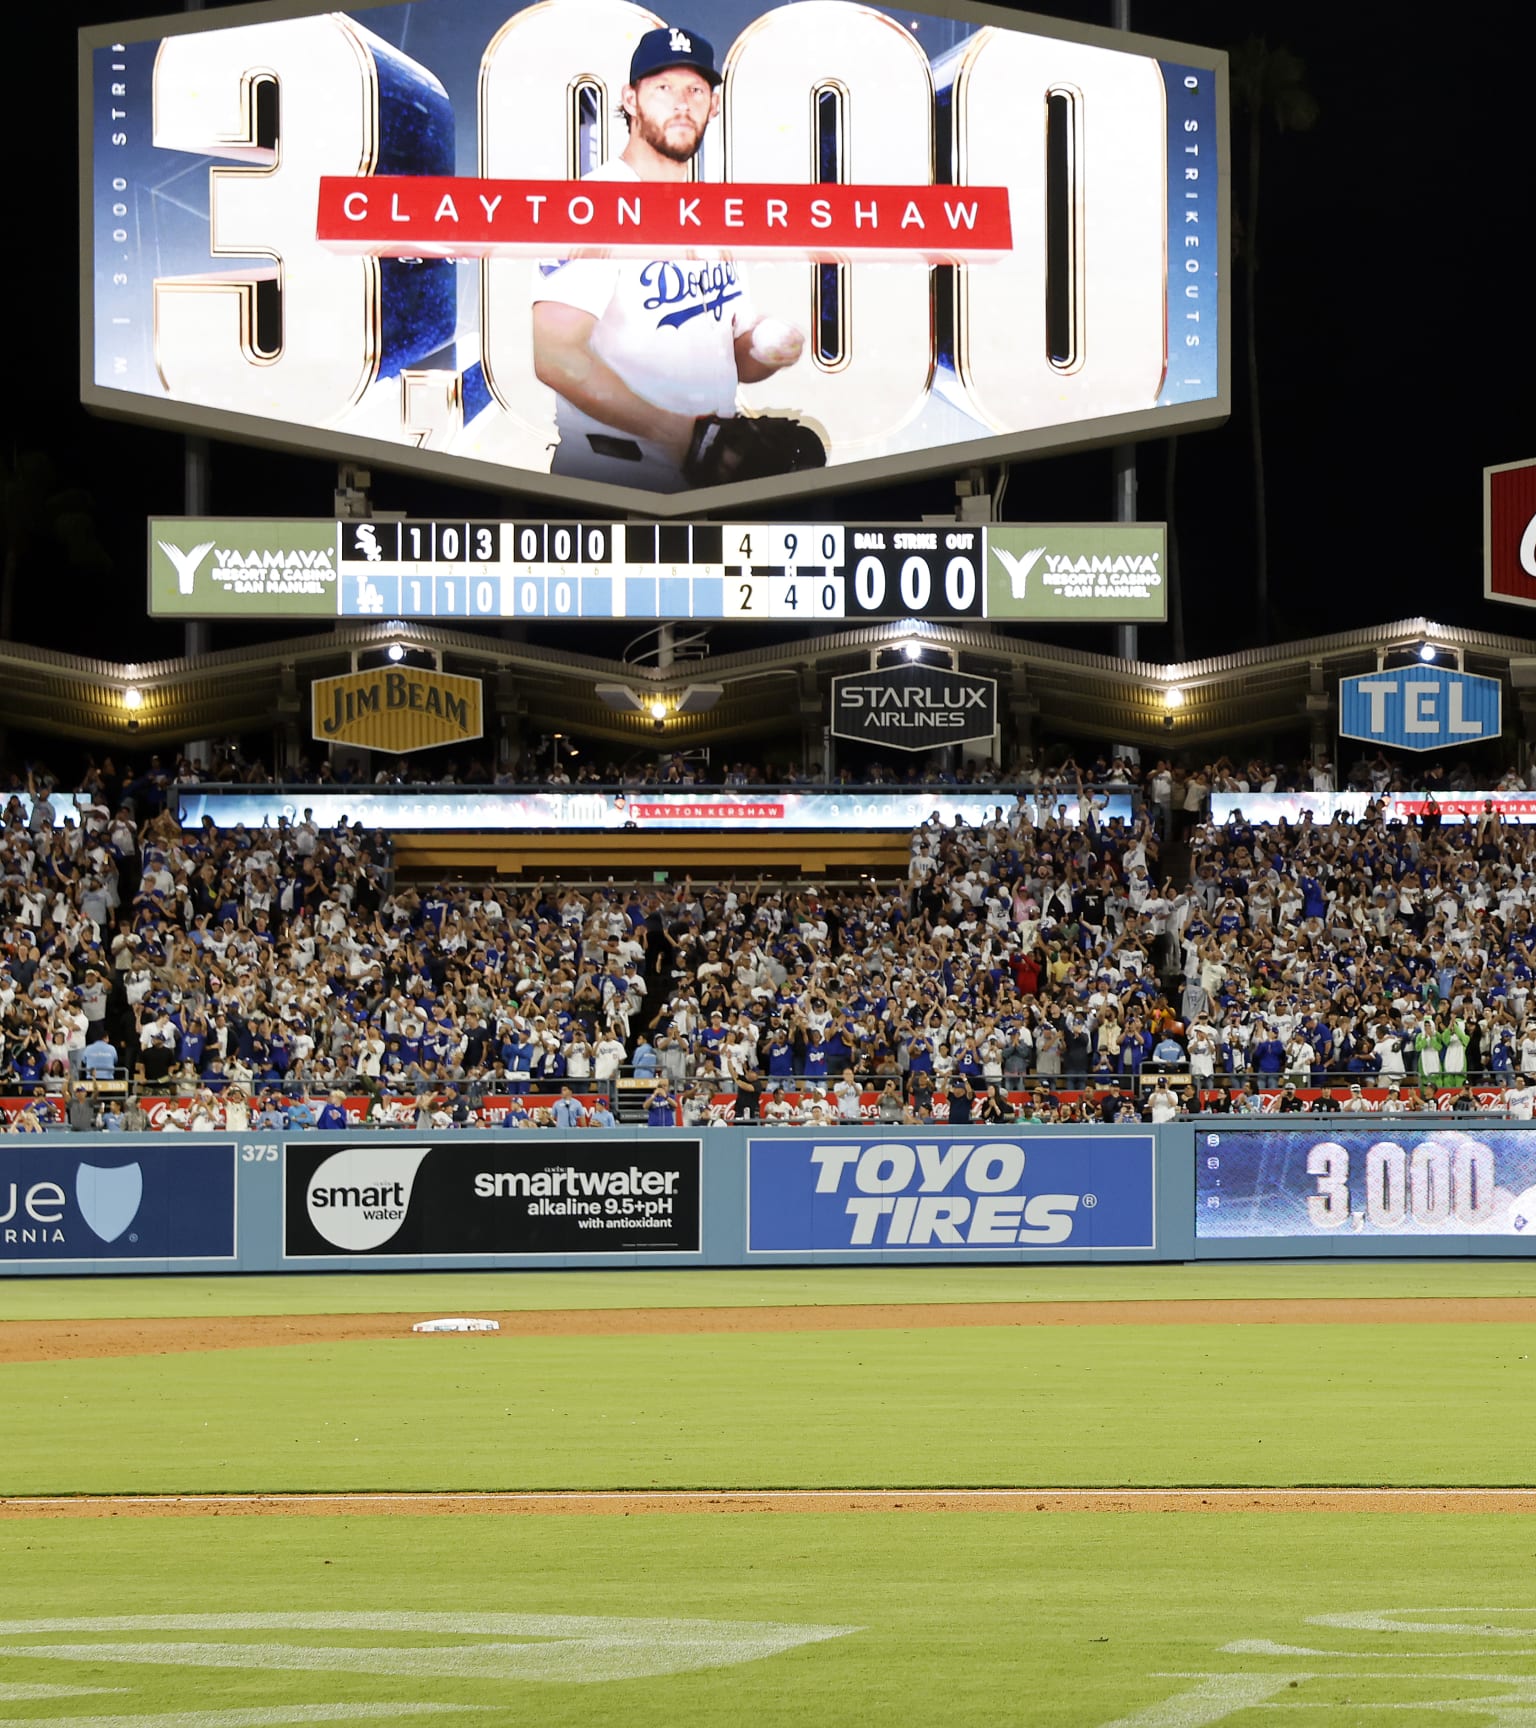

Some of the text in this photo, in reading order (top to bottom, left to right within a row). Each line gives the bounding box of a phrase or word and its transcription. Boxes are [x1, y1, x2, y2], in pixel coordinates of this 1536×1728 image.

[342, 191, 978, 229] CLAYTON KERSHAW
[1184, 119, 1200, 347] STRIKEOUTS
[410, 528, 420, 559] 1
[442, 528, 459, 560] 0
[476, 528, 492, 560] 3
[521, 529, 537, 560] 0
[554, 529, 571, 560] 0
[588, 530, 605, 561] 0
[739, 534, 752, 559] 4
[784, 534, 798, 559] 9
[822, 534, 836, 559] 0
[854, 533, 974, 549] BALL STRIKE OUT
[410, 581, 420, 611] 1
[444, 581, 455, 611] 1
[477, 581, 493, 613] 0
[521, 582, 537, 613] 0
[554, 582, 571, 613] 0
[740, 584, 753, 610] 2
[784, 584, 798, 610] 4
[822, 584, 836, 610] 0
[855, 556, 975, 610] 0 0 0
[324, 673, 468, 733] JIM BEAM
[841, 687, 987, 709] STARLUX
[1358, 681, 1482, 734] TEL
[864, 712, 965, 727] AIRLINES
[708, 808, 778, 816] KERSHAW
[242, 1145, 279, 1162] 375
[474, 1166, 680, 1197] smartwater
[810, 1143, 1025, 1194] TOYO
[312, 1182, 404, 1207] smart
[1306, 1141, 1496, 1233] 3,000
[363, 1208, 405, 1220] water
[528, 1198, 673, 1217] alkaline 9.5+pH
[5, 1229, 65, 1243] RNIA
[578, 1217, 672, 1229] with antioxidant
